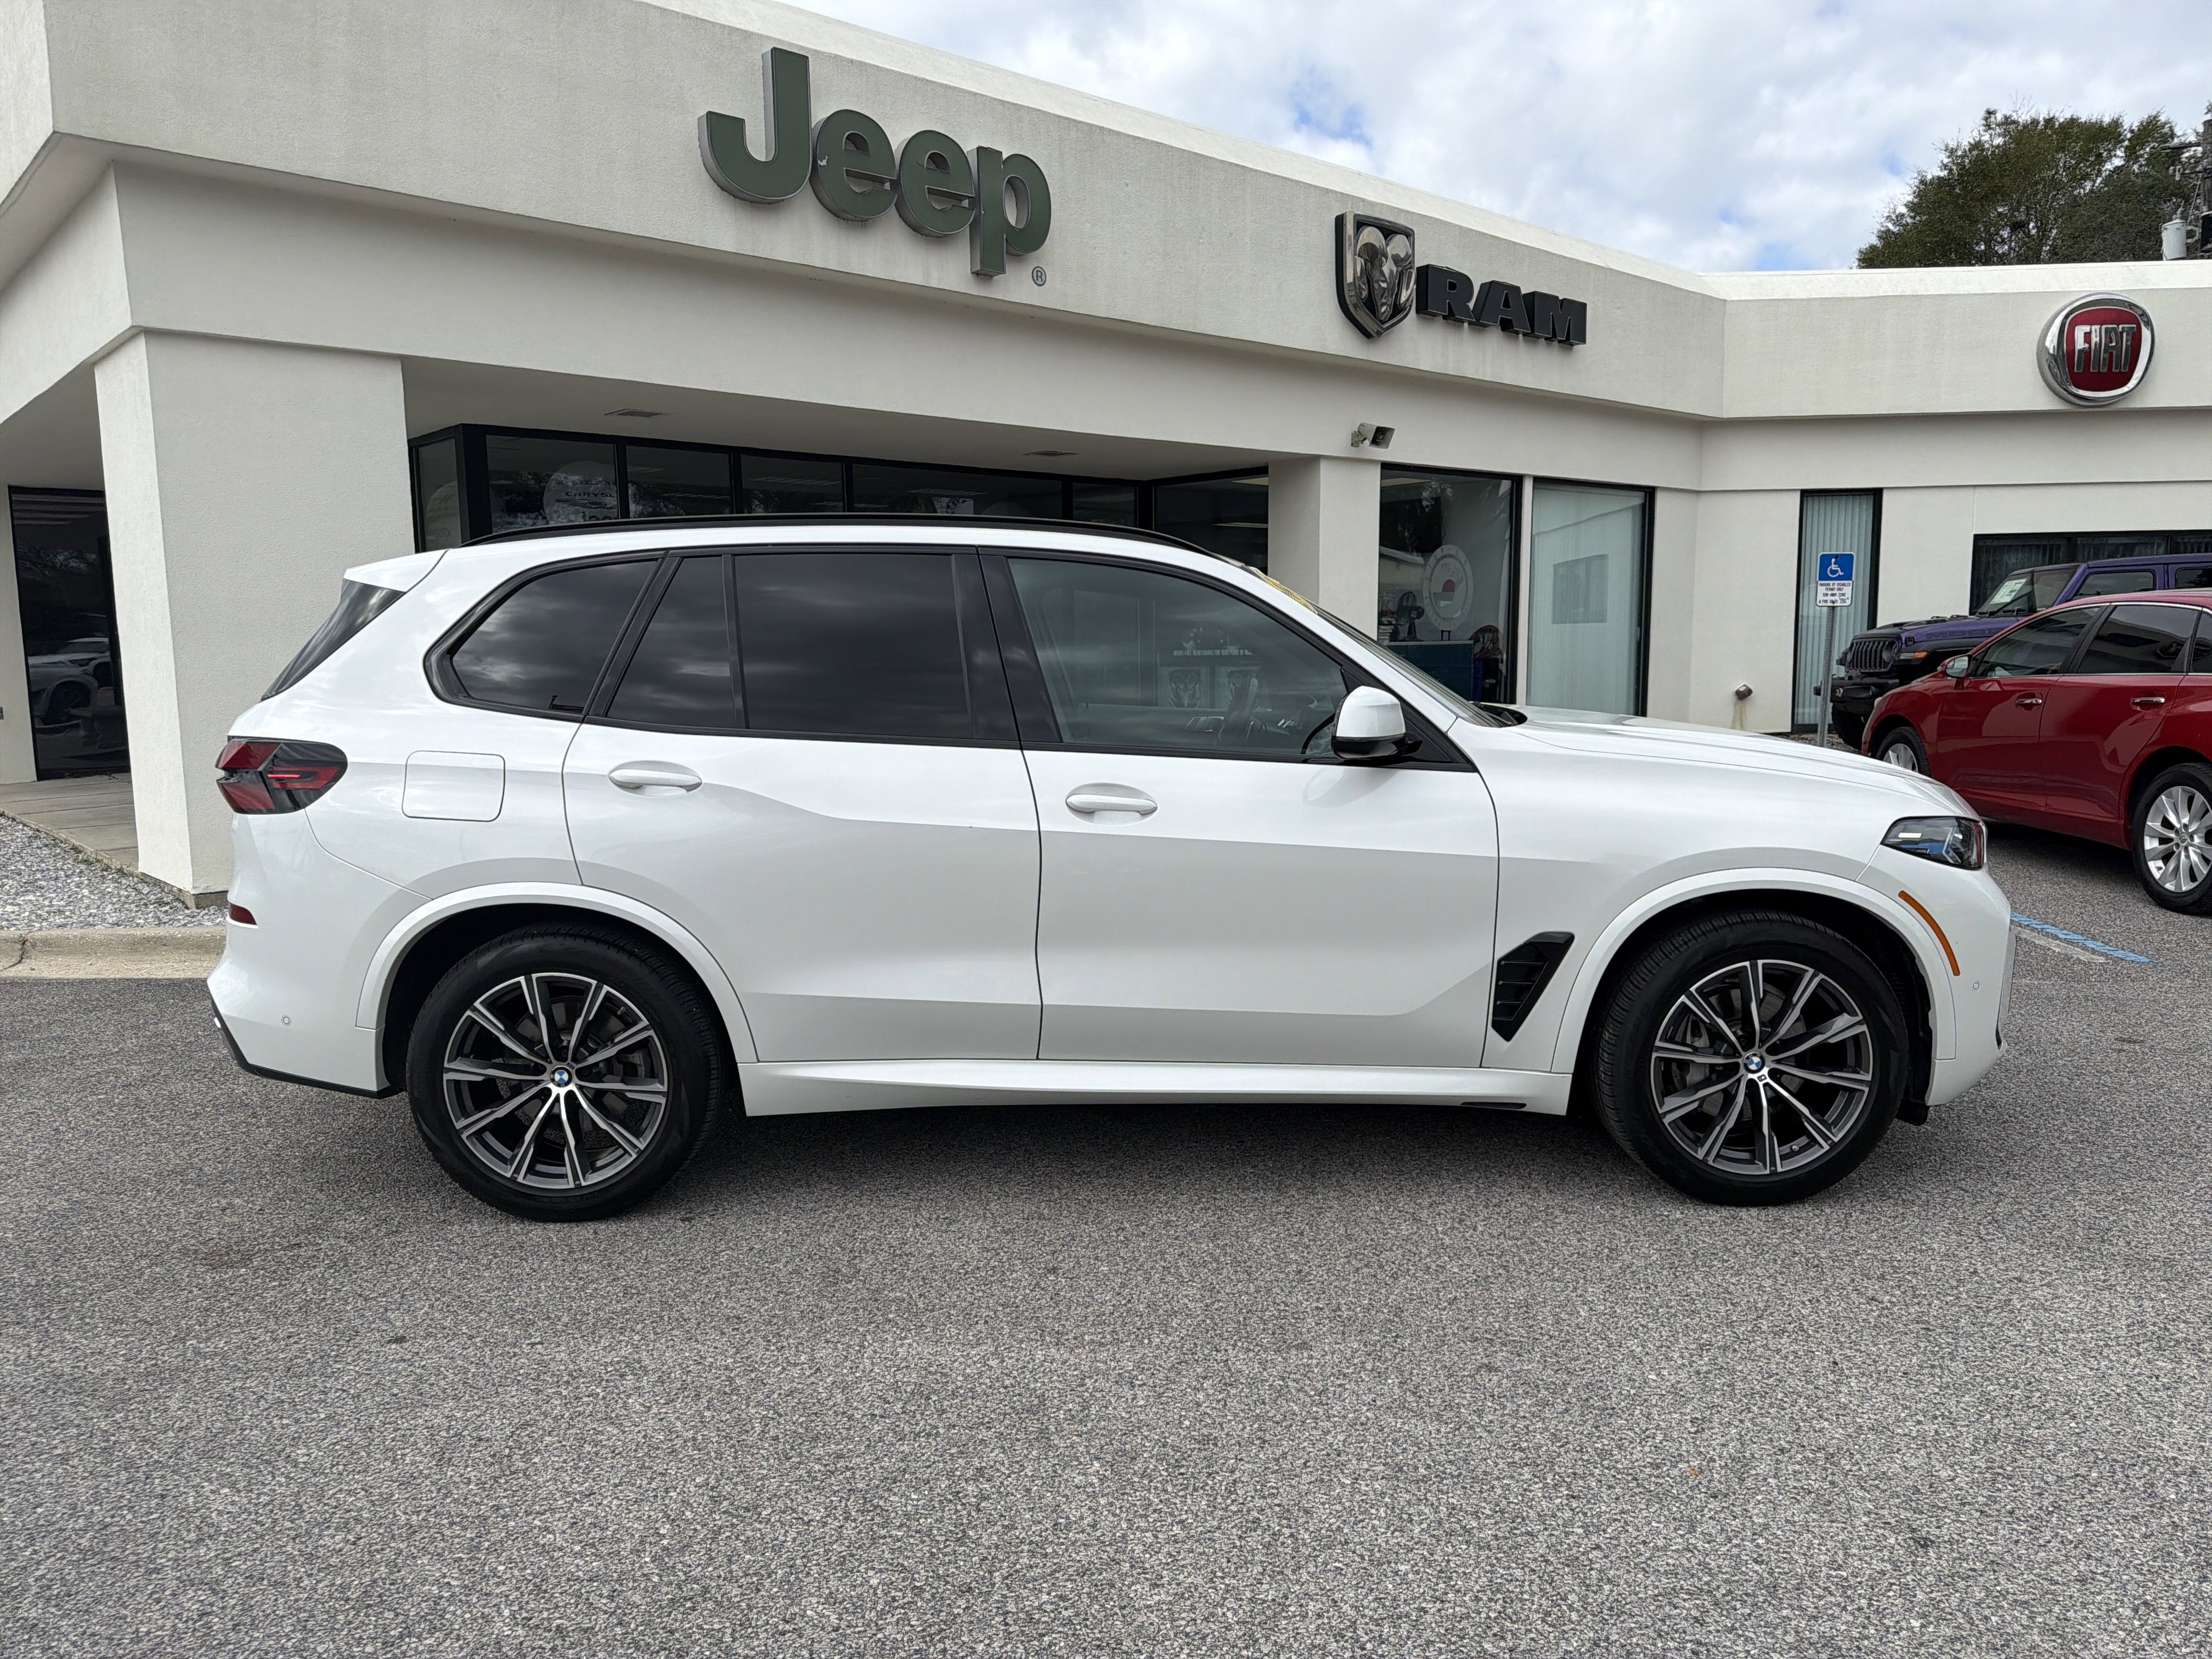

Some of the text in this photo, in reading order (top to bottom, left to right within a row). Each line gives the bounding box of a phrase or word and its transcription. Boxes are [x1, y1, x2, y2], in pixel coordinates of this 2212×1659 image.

[698, 47, 1051, 276] Jeep
[1416, 264, 1587, 346] RAM
[2074, 325, 2136, 373] FIAT
